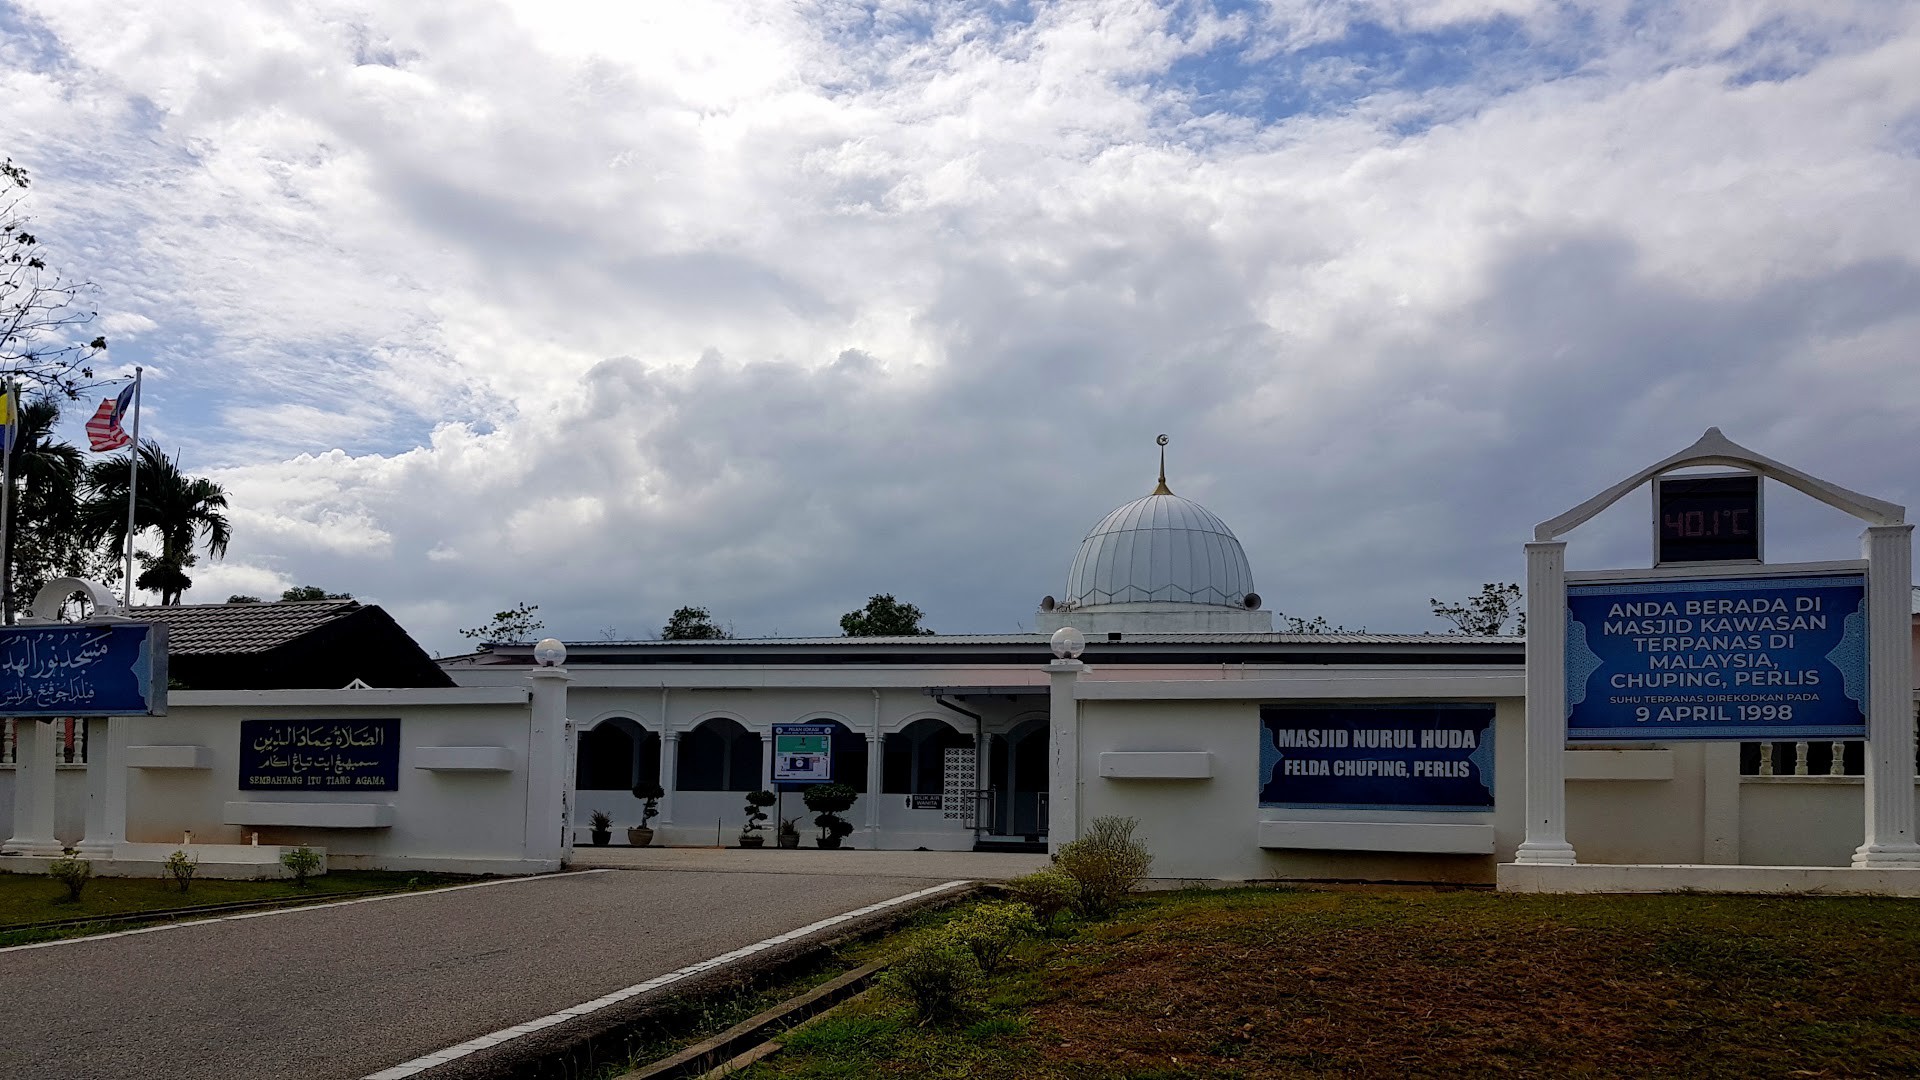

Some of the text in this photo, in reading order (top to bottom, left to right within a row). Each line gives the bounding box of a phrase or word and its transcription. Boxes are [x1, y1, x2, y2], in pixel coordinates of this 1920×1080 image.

[1608, 597, 1821, 618] ANDA BERADA DI
[1603, 614, 1827, 635] MASJID KAWASAN
[1632, 634, 1794, 653] TERPANAS DI
[1649, 652, 1779, 671] MALAYSIA,
[1610, 669, 1820, 689] CHUPING, PERLIS
[1609, 692, 1820, 704] SUHU TERPANAS DIREKODKAN PADA
[1635, 703, 1793, 722] 9 APRIL 1998
[1278, 729, 1477, 749] MASJID NURUL HUDA
[1284, 759, 1471, 778] FELDA CHUPING, PERLIS
[249, 775, 386, 786] SEMBAHYANG ITU TIANG AGAMA
